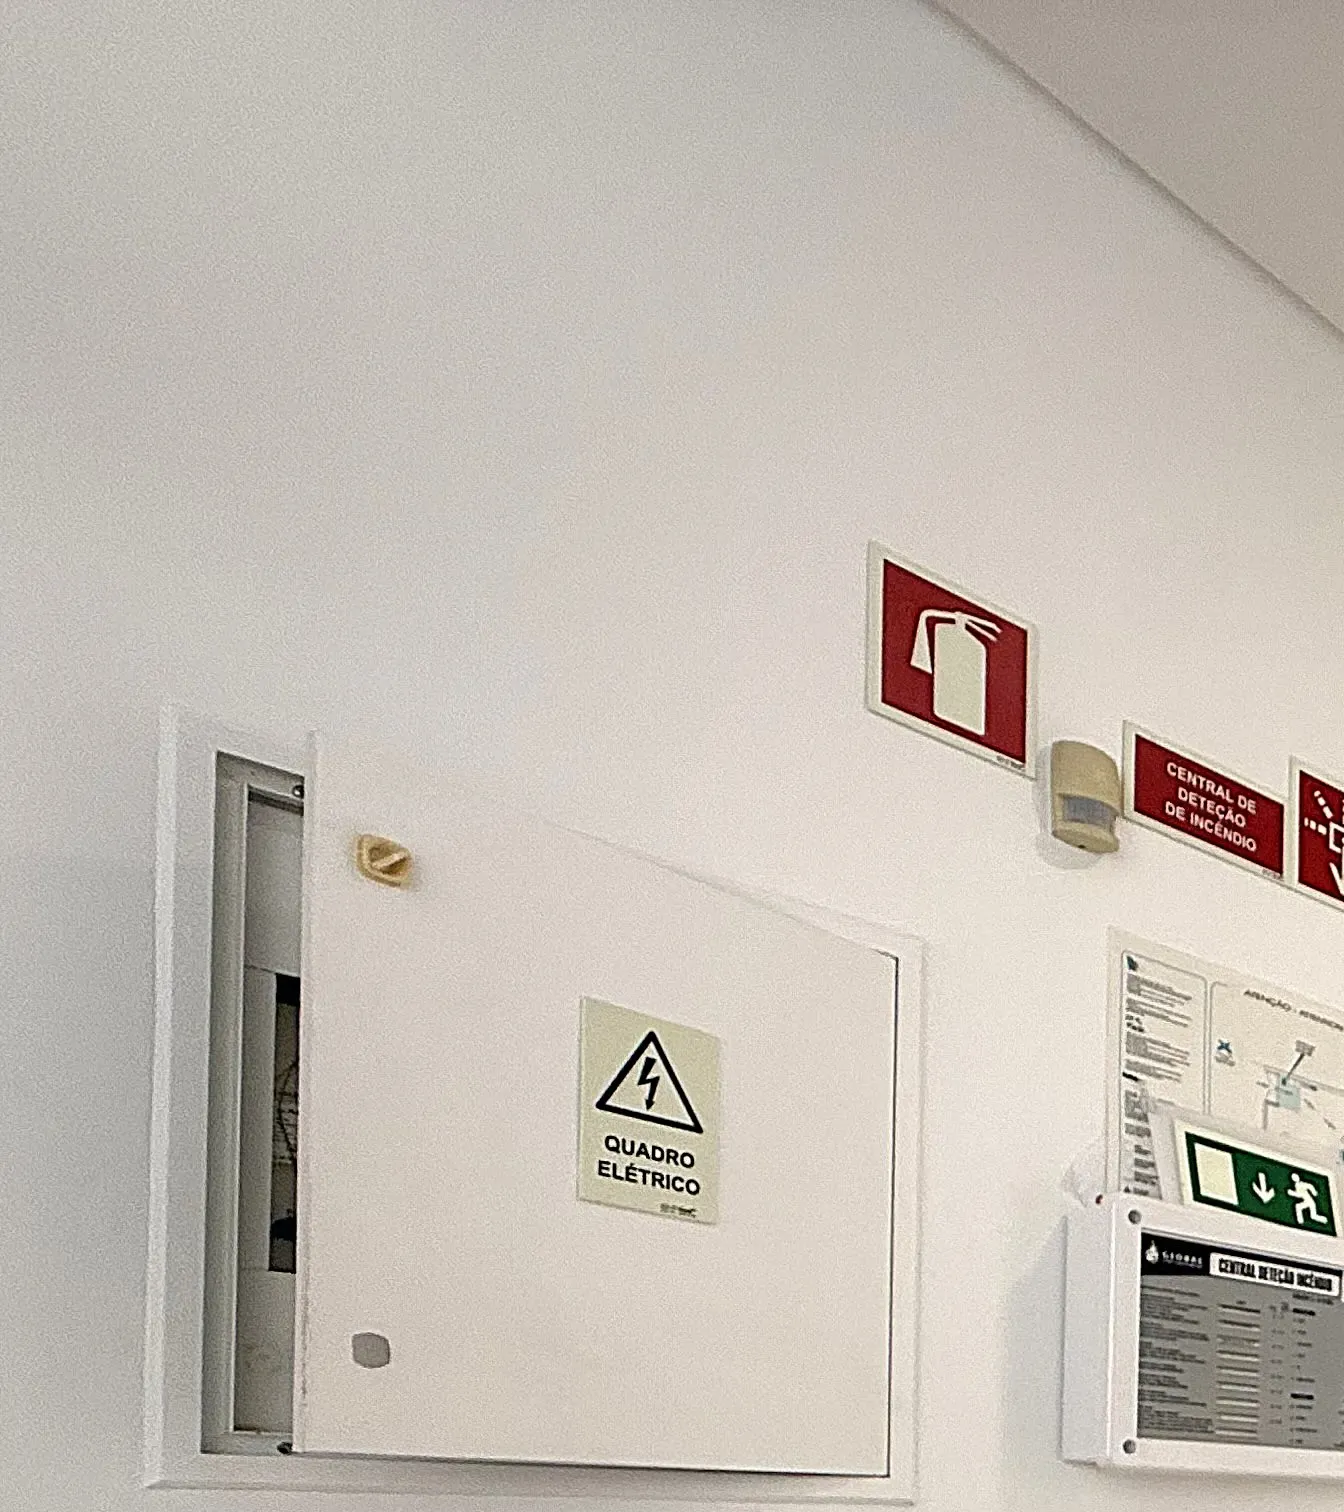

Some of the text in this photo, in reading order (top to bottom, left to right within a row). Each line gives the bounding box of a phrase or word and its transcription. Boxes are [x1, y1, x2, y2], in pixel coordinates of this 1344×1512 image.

[1166, 762, 1257, 815] CENTRAL DE
[1177, 786, 1246, 828] DETEÇÃO
[1164, 801, 1257, 852] DE INCÊNDIO
[605, 1135, 695, 1169] QUADRO
[598, 1160, 701, 1196] ELÉTRICO
